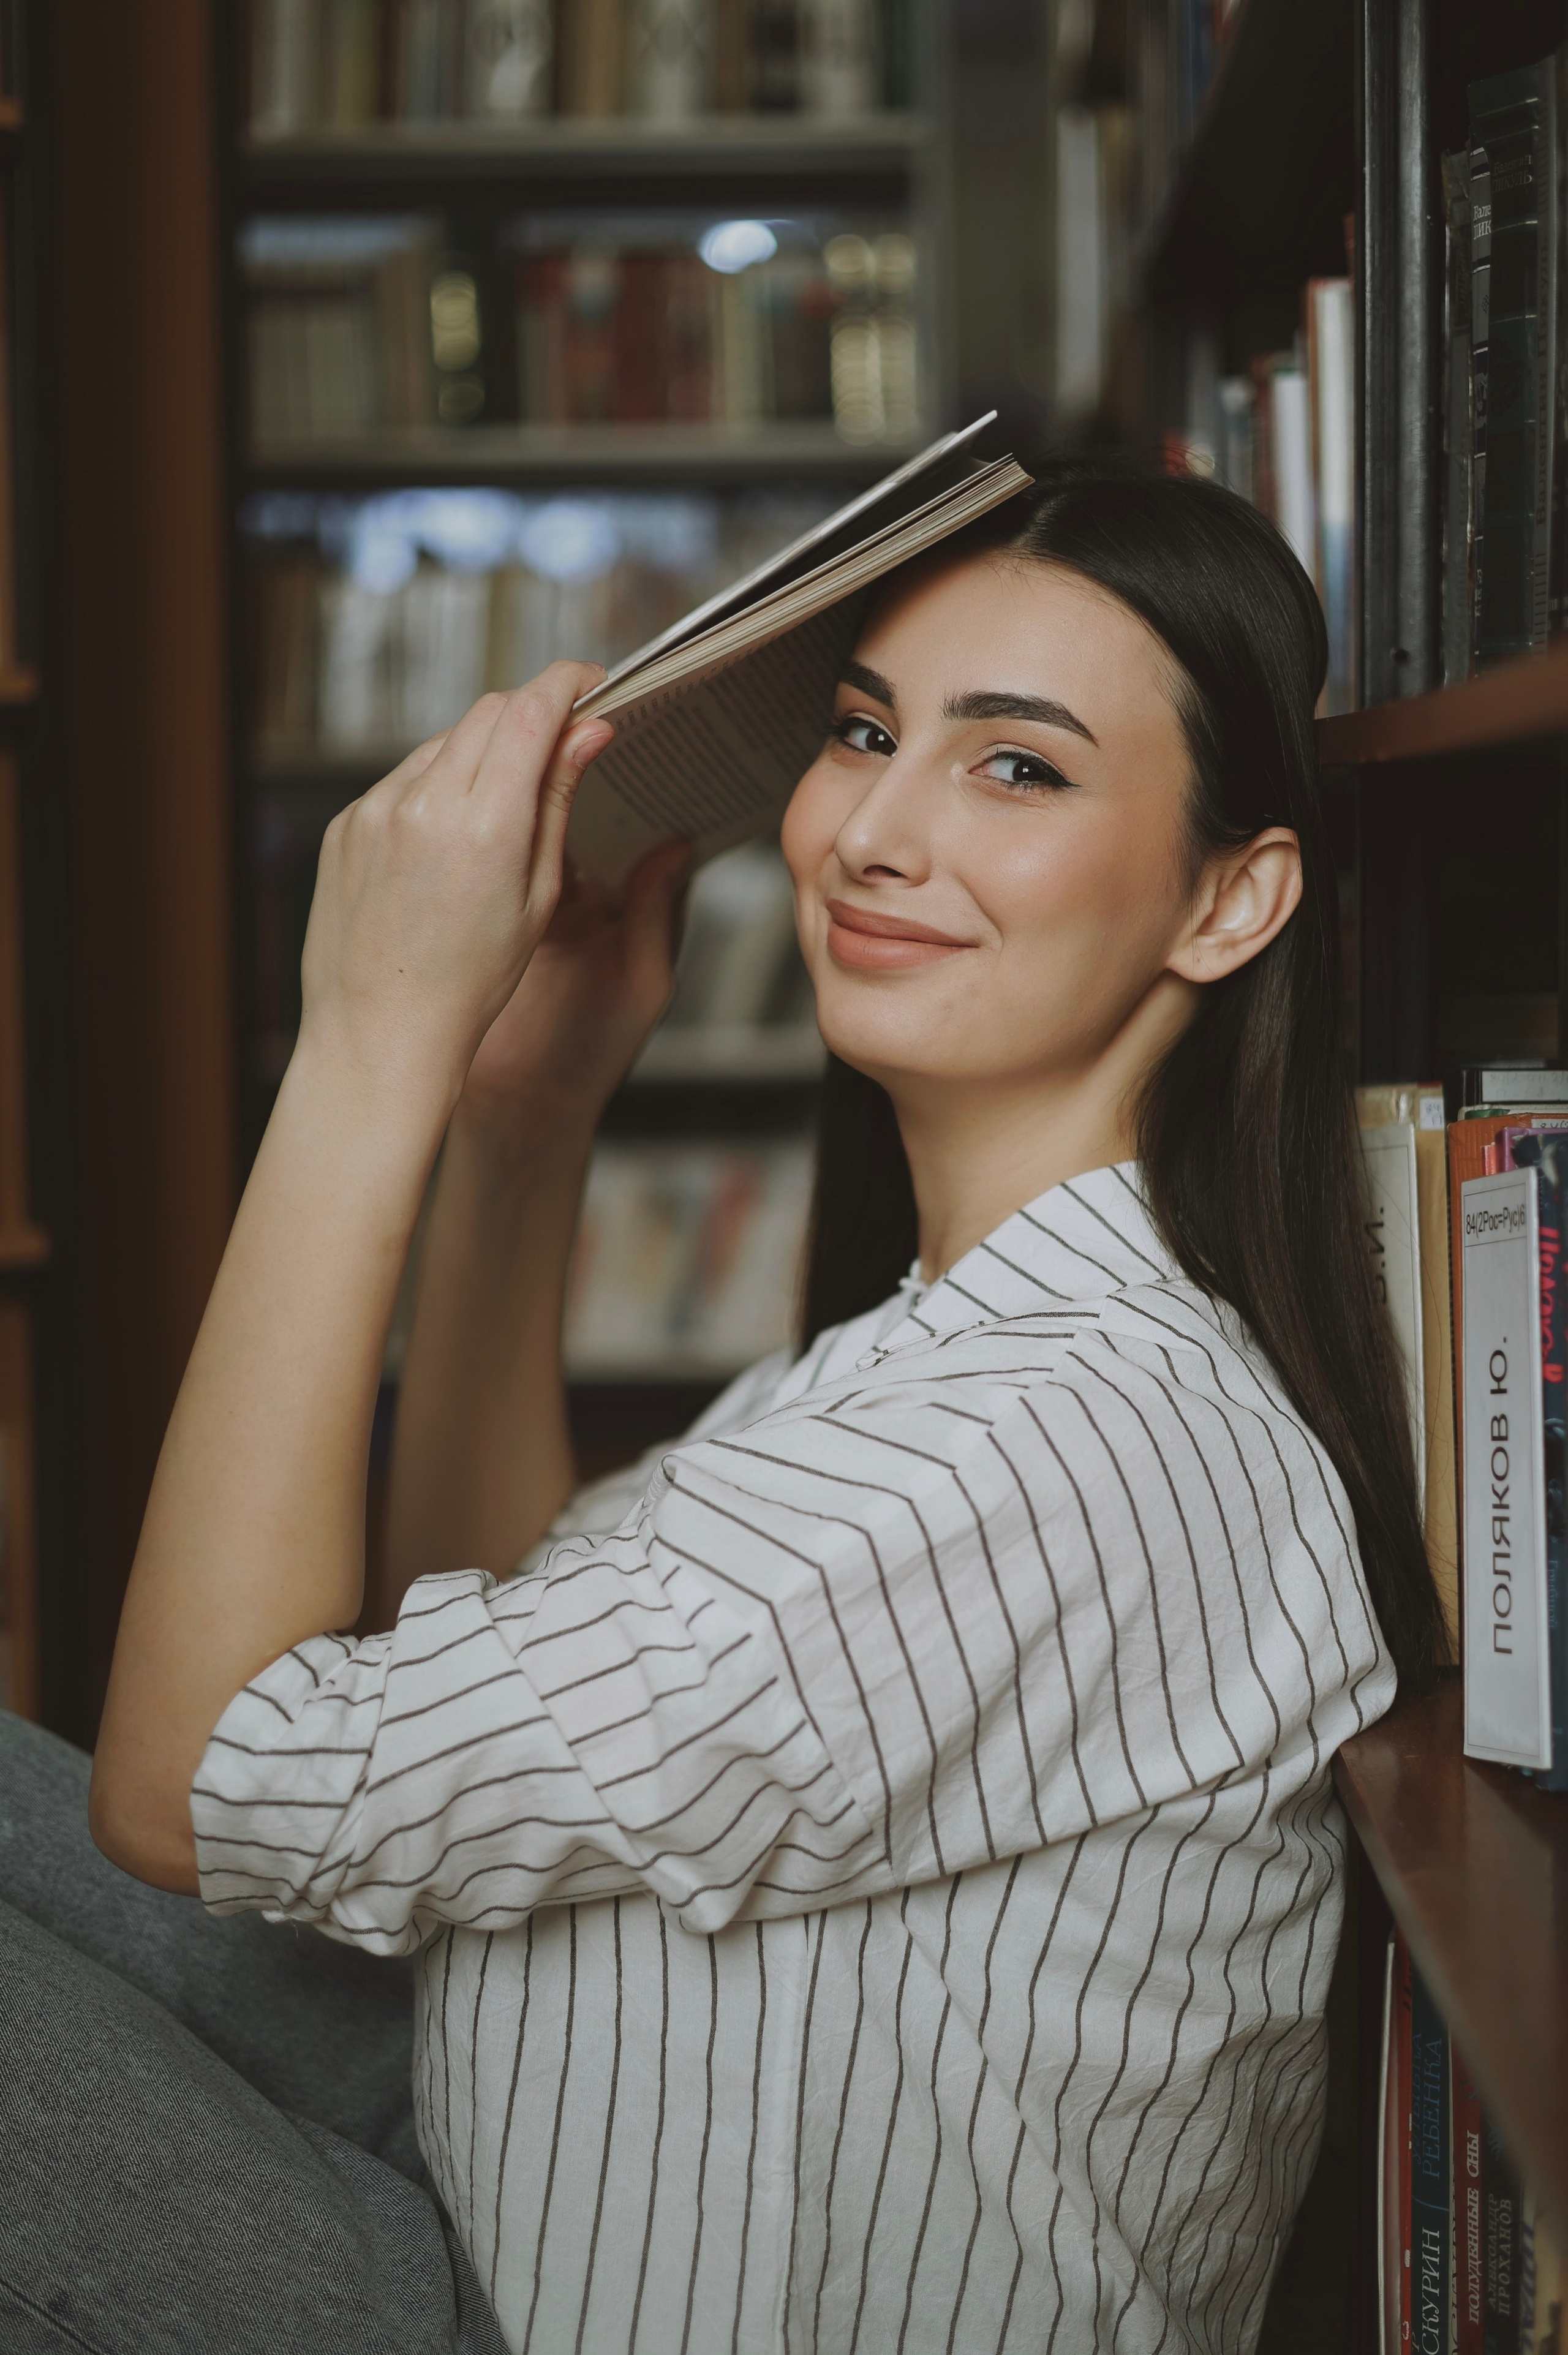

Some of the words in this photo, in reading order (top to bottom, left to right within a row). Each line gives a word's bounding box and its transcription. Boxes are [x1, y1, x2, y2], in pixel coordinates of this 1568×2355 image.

[1489, 1336, 1508, 1395] Ю.
[1491, 1413, 1513, 1654] ПОЛЯКОВ
[1422, 2038, 1442, 2180] РЕБЕНКА
[1466, 2129, 1479, 2179] СНЫ
[1466, 2187, 1483, 2326] ПОЛУДЕННЫЕ
[1487, 2192, 1499, 2311] АЛЕКСАНДР
[1499, 2198, 1512, 2317] ПРОХАНОВ
